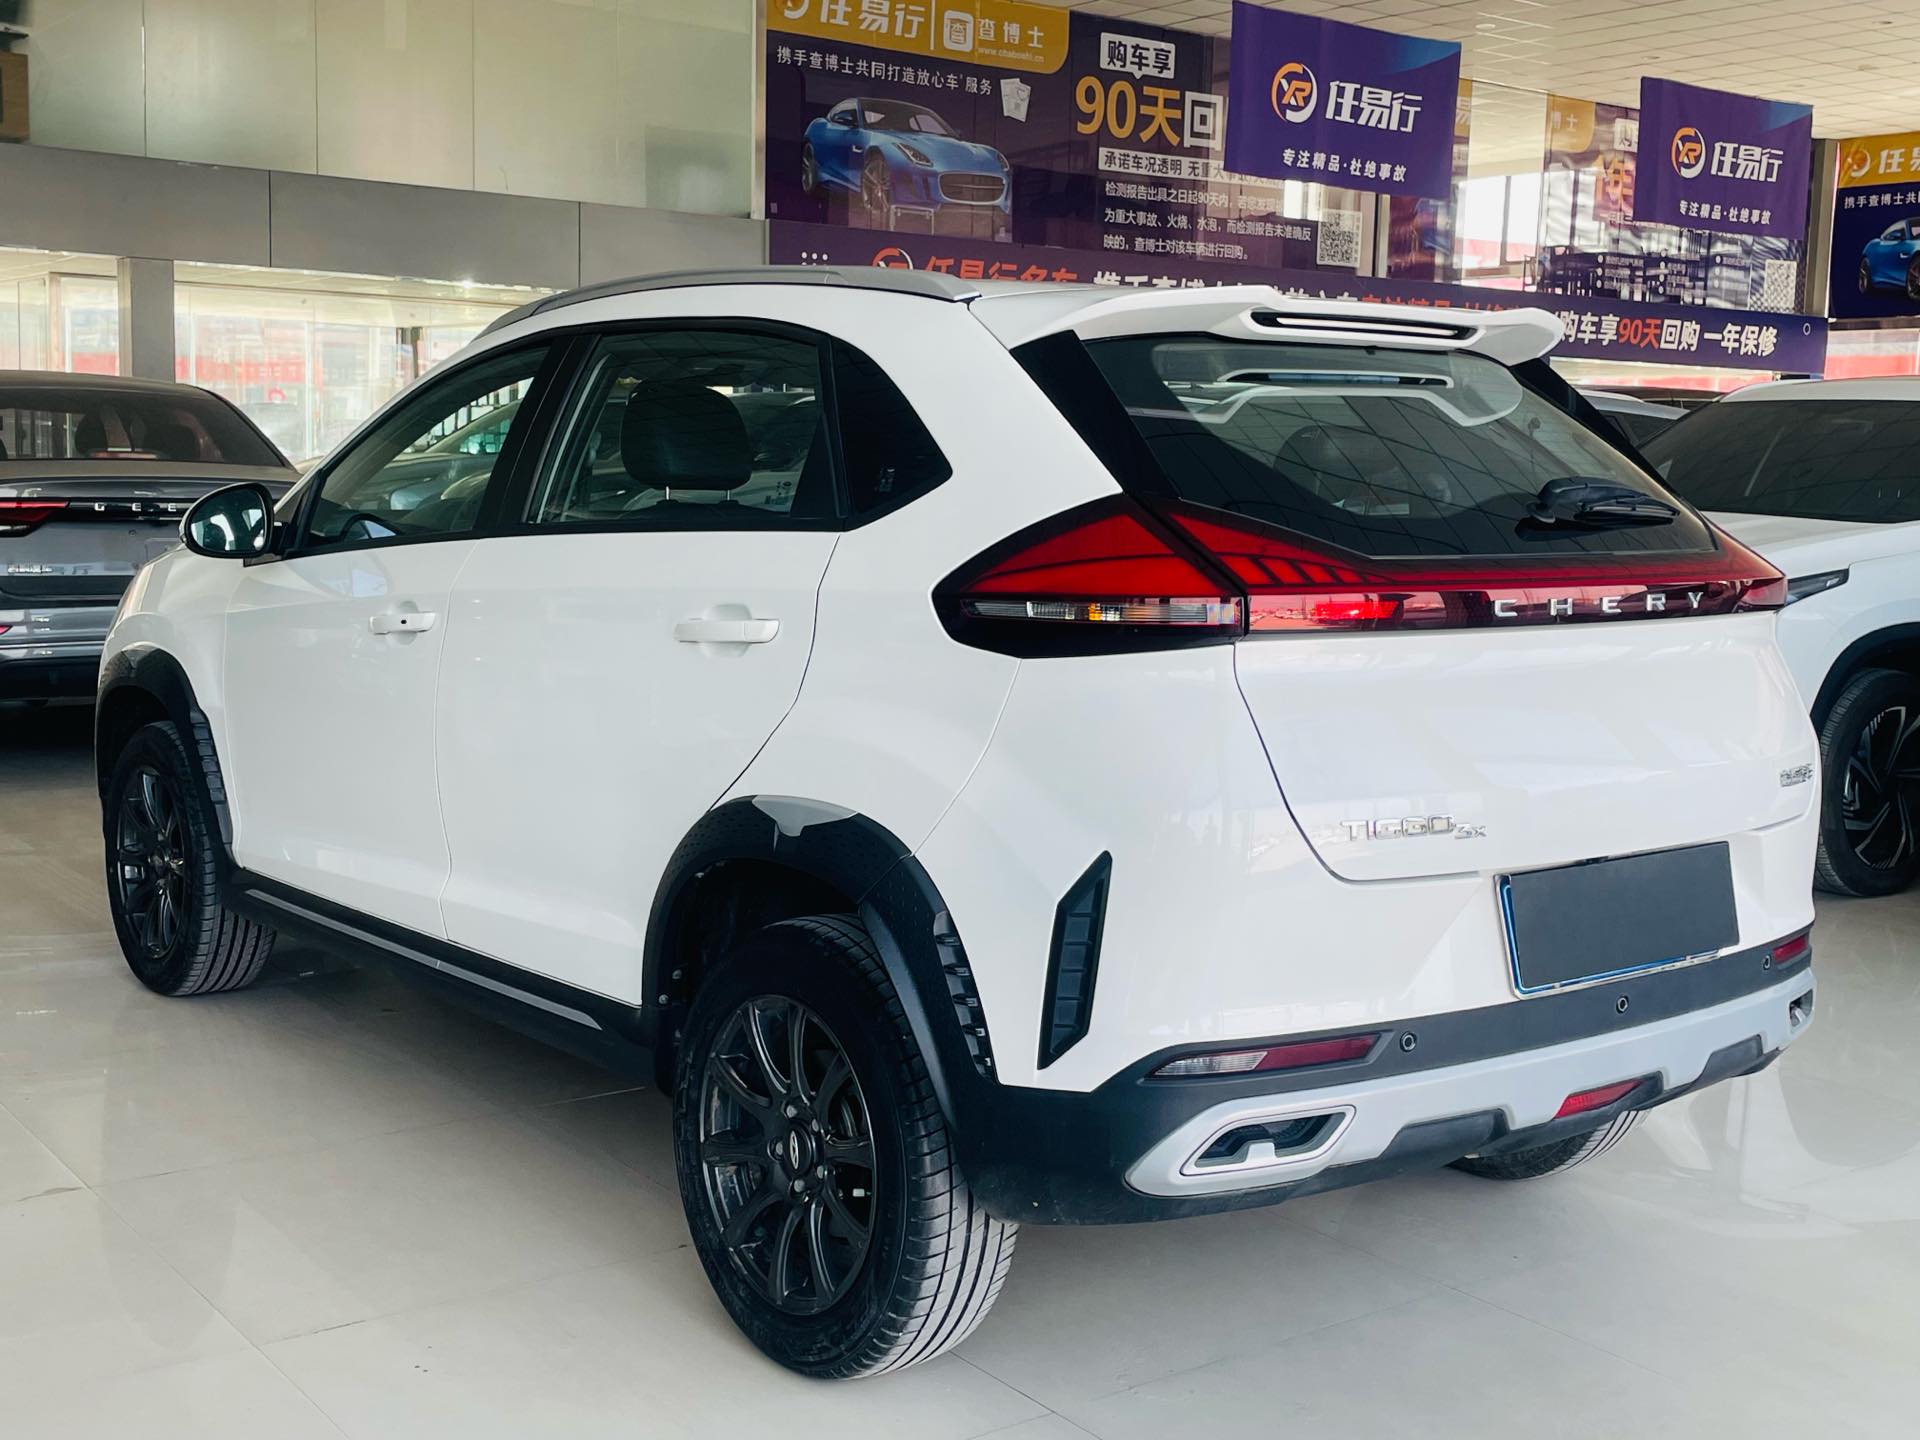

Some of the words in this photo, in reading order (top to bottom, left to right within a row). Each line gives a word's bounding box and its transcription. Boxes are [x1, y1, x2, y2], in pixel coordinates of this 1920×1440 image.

[819, 0, 925, 39] 任易行
[977, 18, 1045, 49] 查博士
[1107, 40, 1172, 74] 购车享
[1075, 75, 1229, 151] 90天回
[1325, 80, 1423, 133] 任易行
[1104, 151, 1182, 176] 承诺车况透明
[1282, 148, 1407, 183] 专注精品·杜绝事故
[1711, 141, 1784, 182] 任易行
[1679, 199, 1772, 225] 专注精品·杜绝事故
[1844, 189, 1920, 209] 携手查博士共
[1556, 309, 1700, 352] 购车享90天回购
[1704, 322, 1778, 357] 一年保修
[1493, 590, 1704, 618] CHERY
